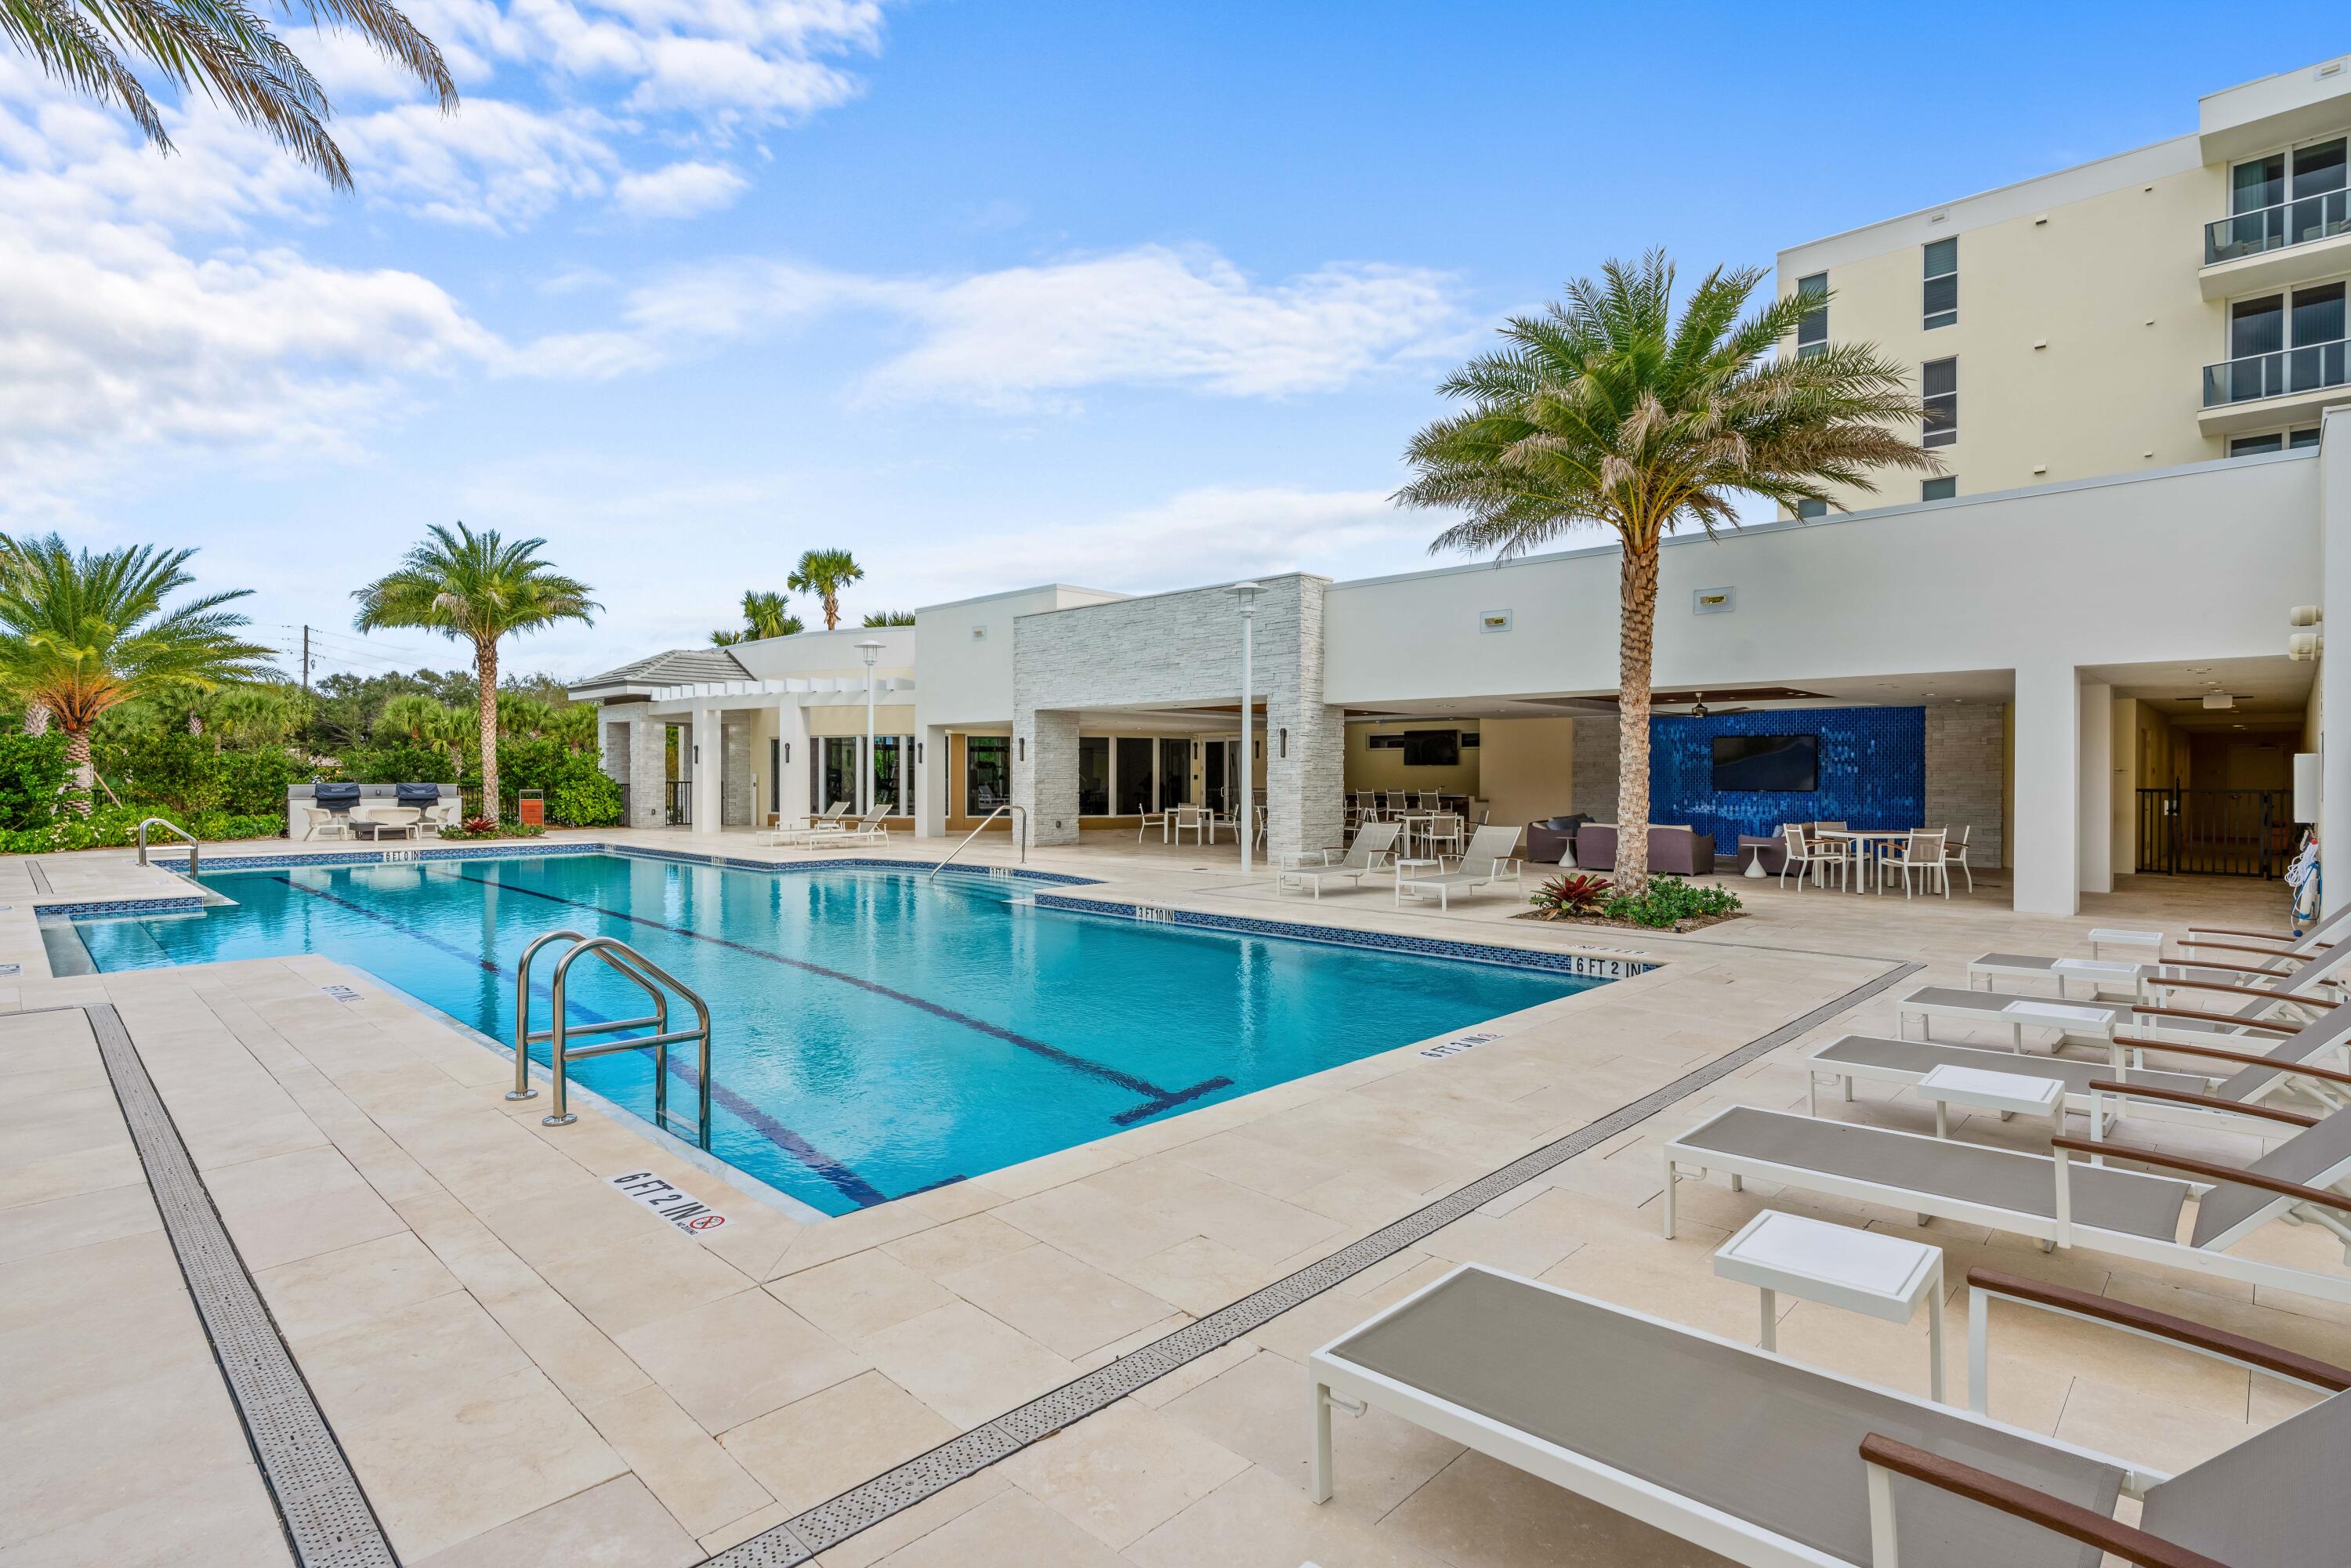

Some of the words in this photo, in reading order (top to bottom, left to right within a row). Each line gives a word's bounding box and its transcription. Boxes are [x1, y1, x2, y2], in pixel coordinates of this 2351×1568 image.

[995, 867, 1002, 878] FT
[1007, 869, 1013, 878] IN
[1139, 907, 1143, 918] 3
[1145, 907, 1154, 919] FT
[1155, 909, 1164, 921] 10
[1165, 910, 1173, 922] IN
[1576, 957, 1584, 972] 6
[1588, 958, 1606, 975] FT
[1610, 961, 1619, 975] 2
[1625, 962, 1641, 978] IN
[1430, 1045, 1462, 1055] FT
[1460, 1036, 1491, 1045] IN
[614, 1172, 652, 1183] 6
[623, 1179, 675, 1197] FT
[648, 1194, 683, 1206] 2
[659, 1201, 712, 1222] IN
[680, 1225, 698, 1236] DIVING
